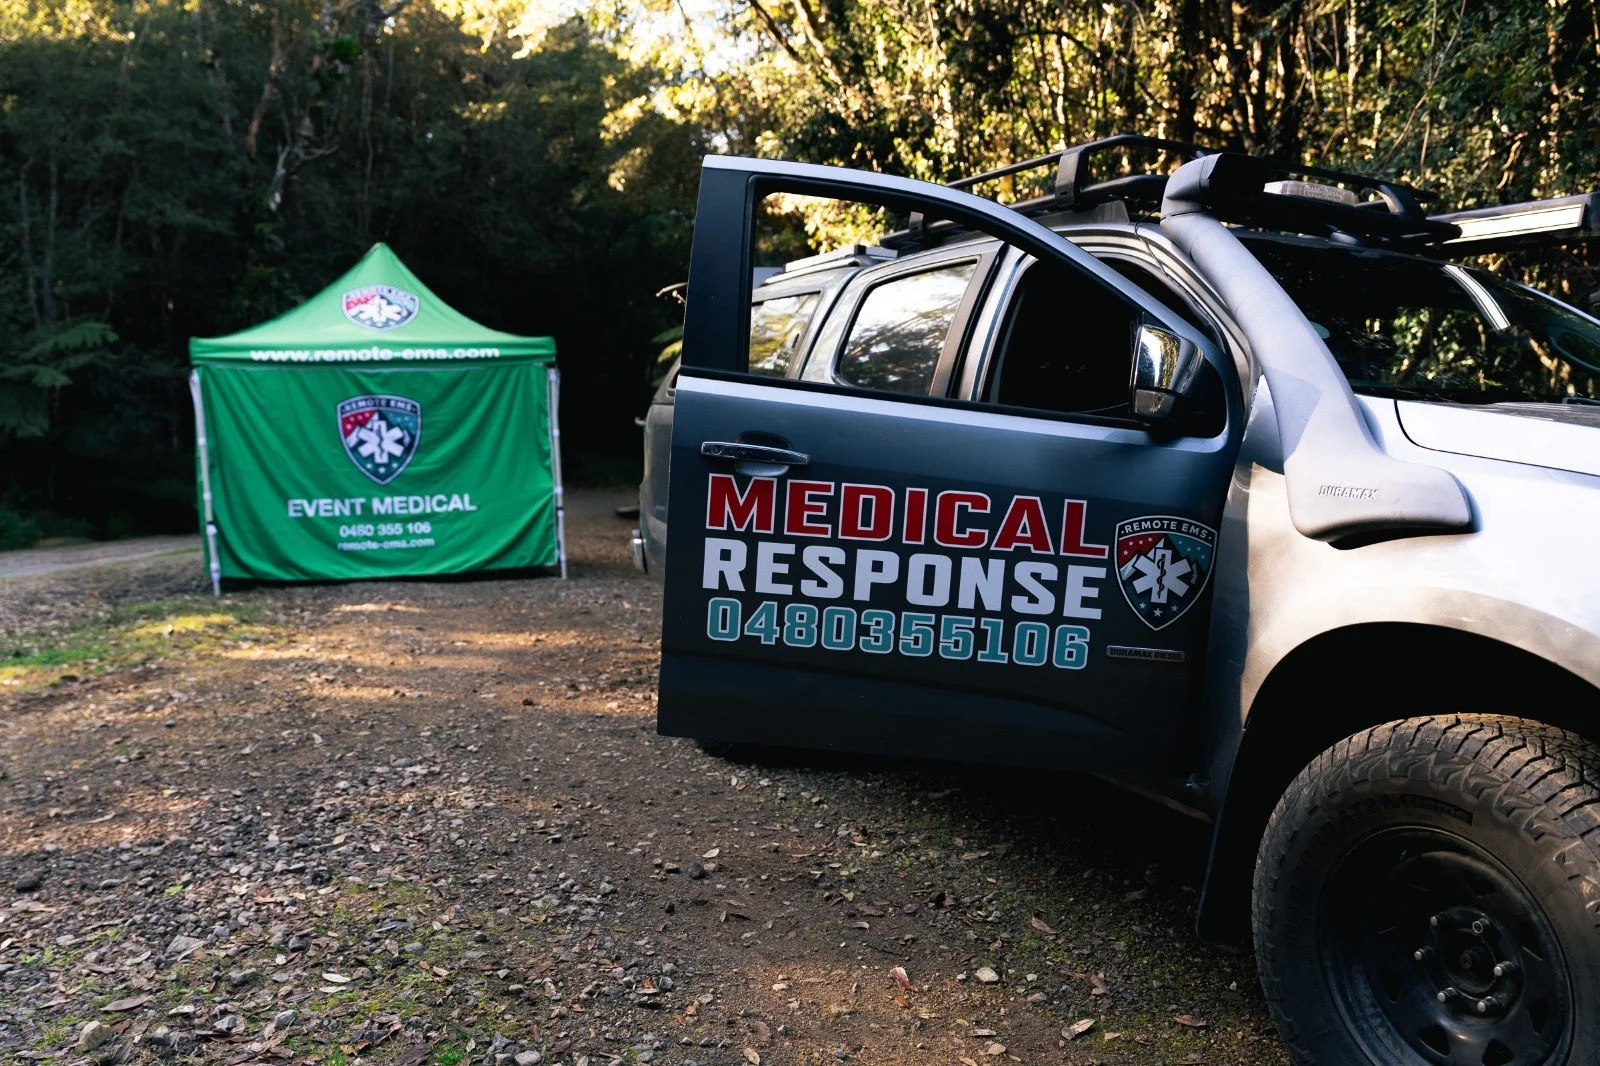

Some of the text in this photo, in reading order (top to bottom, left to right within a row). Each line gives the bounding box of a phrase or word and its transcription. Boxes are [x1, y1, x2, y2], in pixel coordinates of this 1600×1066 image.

[250, 345, 500, 362] www.remote-ems.com
[1317, 484, 1379, 501] DURAMAX
[288, 493, 478, 518] EVENT MEDICAL
[704, 473, 1110, 559] MEDICAL
[377, 523, 404, 536] 355
[1124, 519, 1208, 540] REMOTE EMS
[702, 537, 1108, 620] RESPONSE
[706, 597, 1091, 670] 0480355106
[1110, 648, 1184, 661] DURAMAX DIESEL
